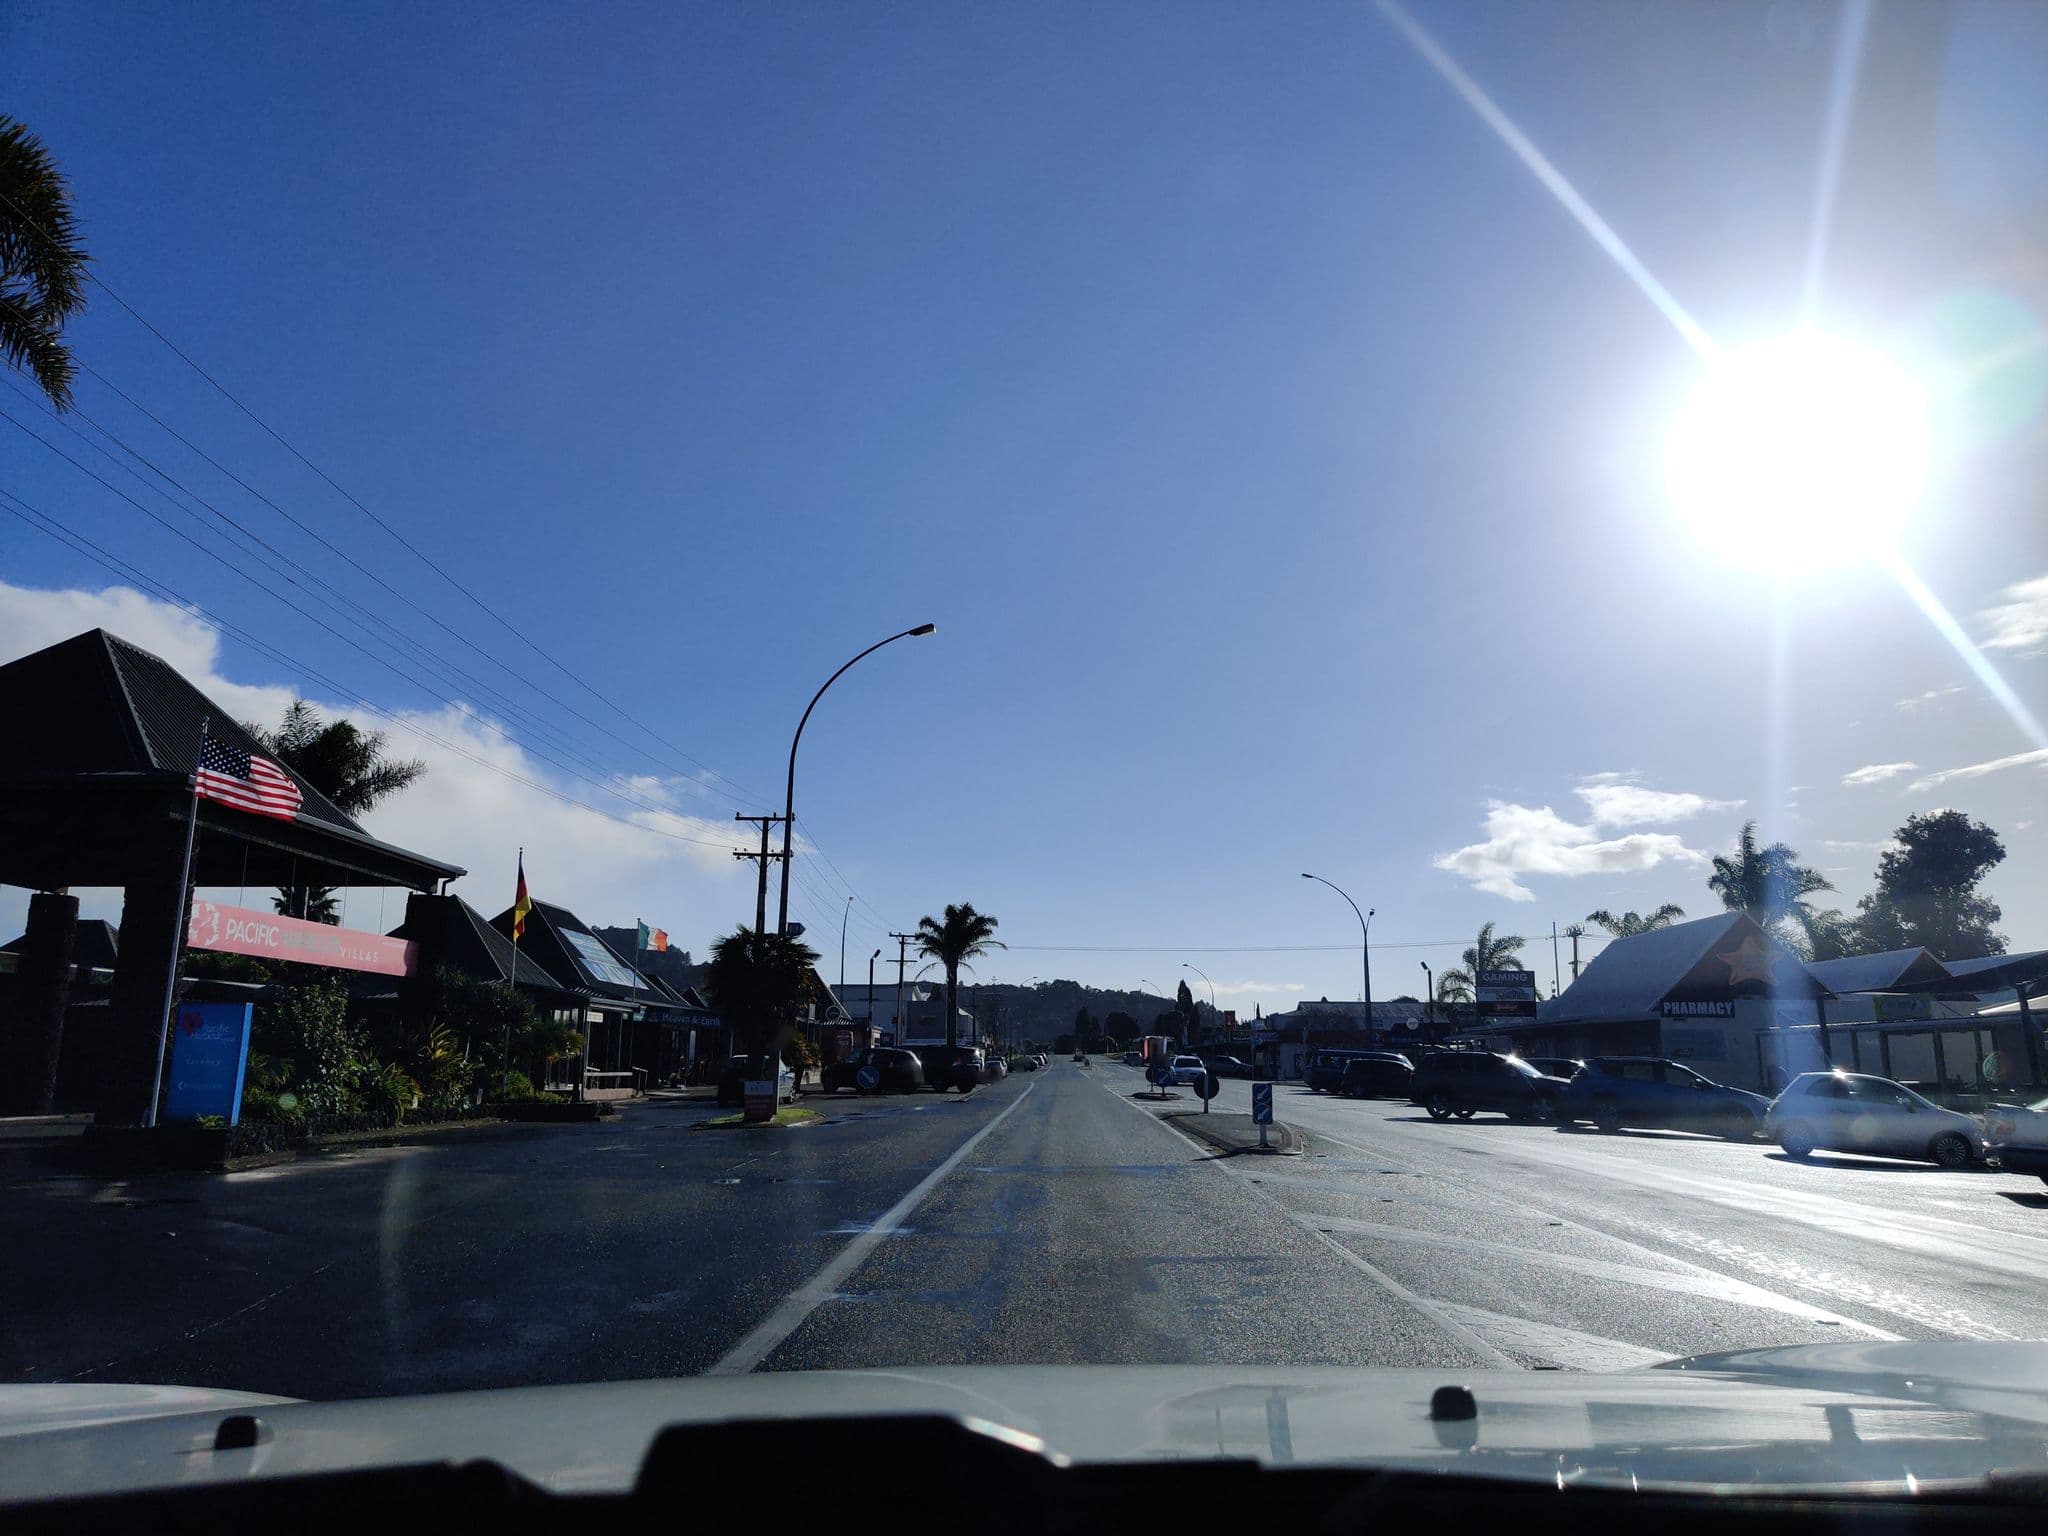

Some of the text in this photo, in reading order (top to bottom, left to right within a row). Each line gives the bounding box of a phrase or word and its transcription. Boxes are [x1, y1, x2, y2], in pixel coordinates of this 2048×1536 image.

[225, 918, 280, 947] PACIFIC
[340, 947, 378, 962] VILLAS
[1482, 973, 1528, 982] GAMING
[1663, 1001, 1734, 1015] PHARMACY
